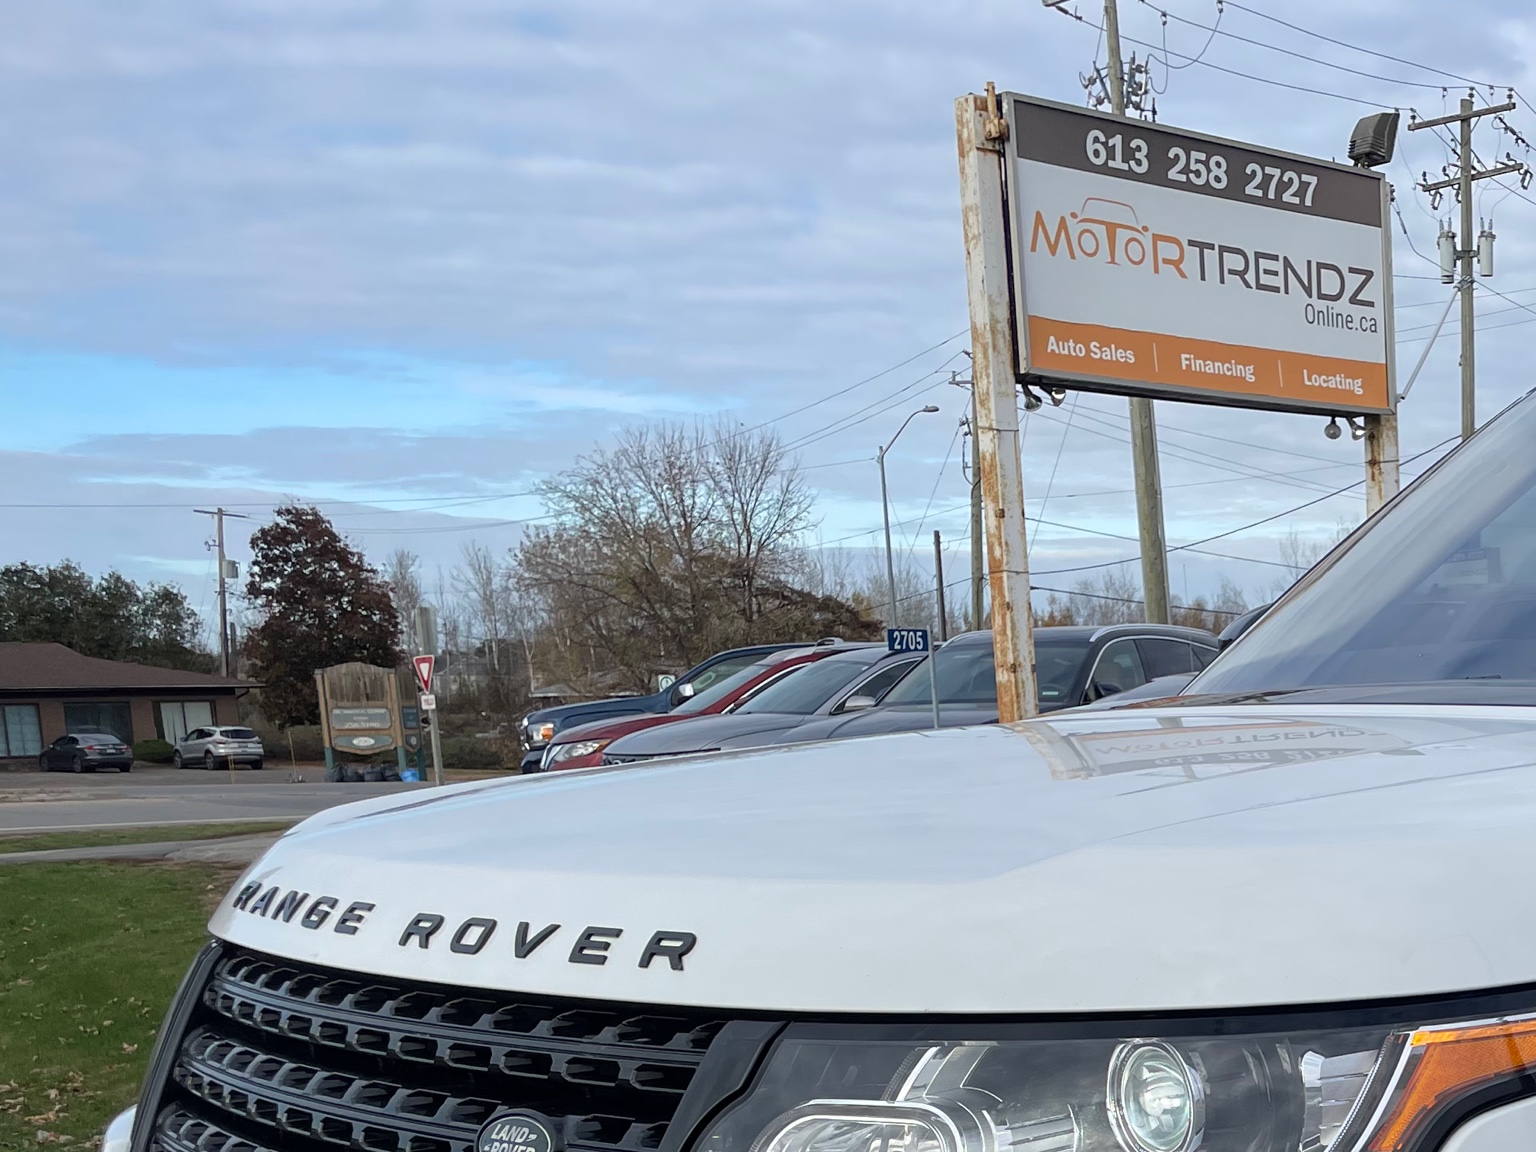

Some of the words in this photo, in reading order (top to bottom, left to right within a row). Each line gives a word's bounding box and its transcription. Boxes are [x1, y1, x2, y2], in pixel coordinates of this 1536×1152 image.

[1085, 129, 1150, 175] 613
[1167, 146, 1229, 190] 258
[1245, 163, 1320, 207] 2727
[1304, 303, 1378, 334] Online.ca
[1047, 335, 1086, 359] Auto
[1089, 341, 1136, 364] Sales
[1180, 353, 1256, 382] Financing
[1303, 369, 1364, 395] Locating
[893, 630, 924, 650] 2705
[232, 880, 377, 936] RANGE
[398, 912, 698, 971] ROVER
[490, 1123, 530, 1143] LAND
